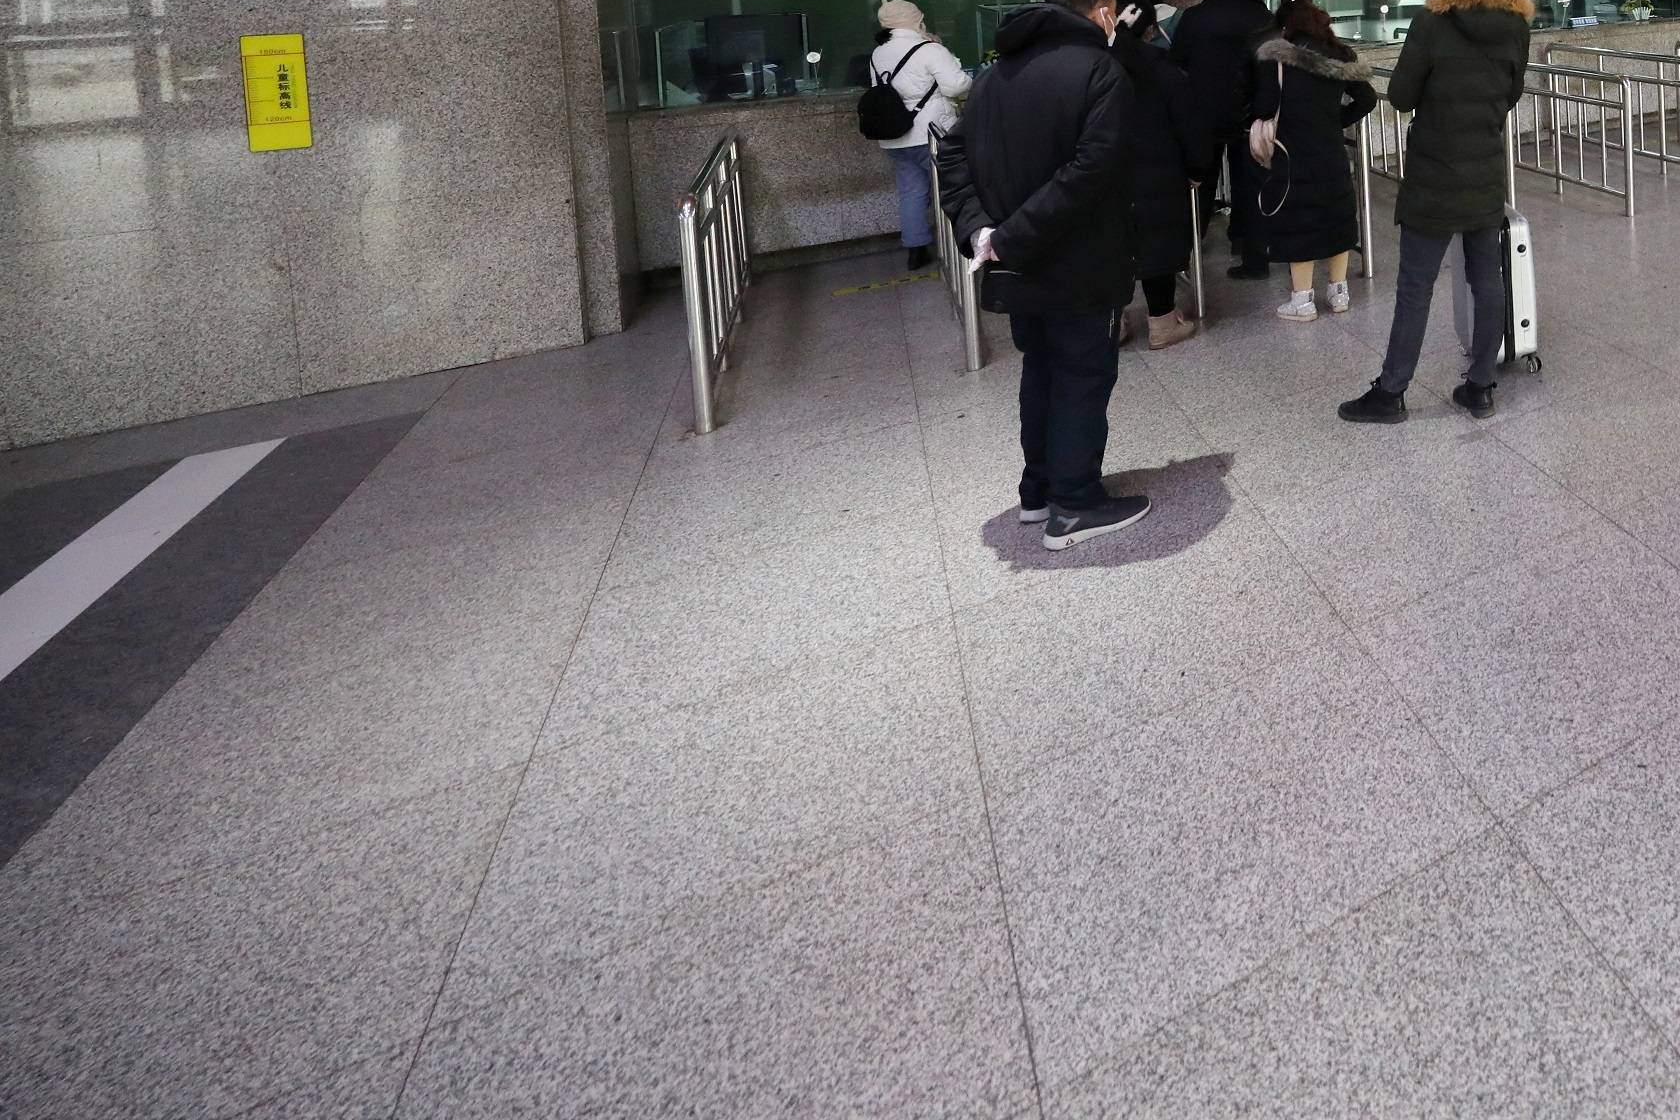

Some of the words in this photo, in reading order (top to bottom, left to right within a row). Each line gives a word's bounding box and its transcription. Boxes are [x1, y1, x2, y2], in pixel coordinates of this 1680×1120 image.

[277, 64, 291, 109] 儿童标高线
